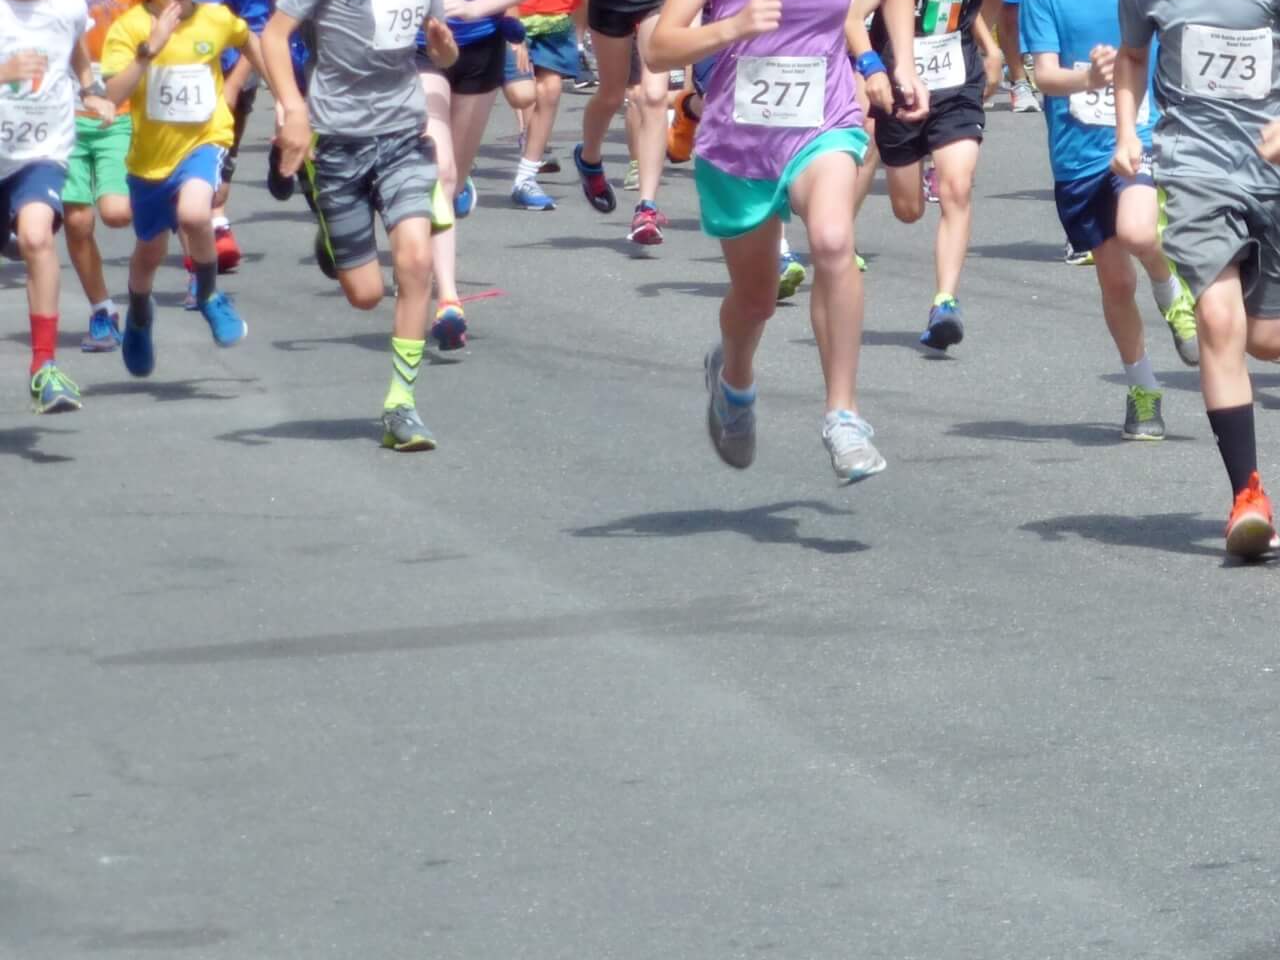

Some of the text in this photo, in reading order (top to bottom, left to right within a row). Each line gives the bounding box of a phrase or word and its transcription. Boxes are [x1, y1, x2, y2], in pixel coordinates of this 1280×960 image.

[386, 6, 425, 32] 795
[914, 52, 952, 76] 544
[1197, 50, 1257, 81] 773
[159, 85, 203, 106] 541
[751, 79, 811, 107] 277
[0, 121, 49, 143] 526
